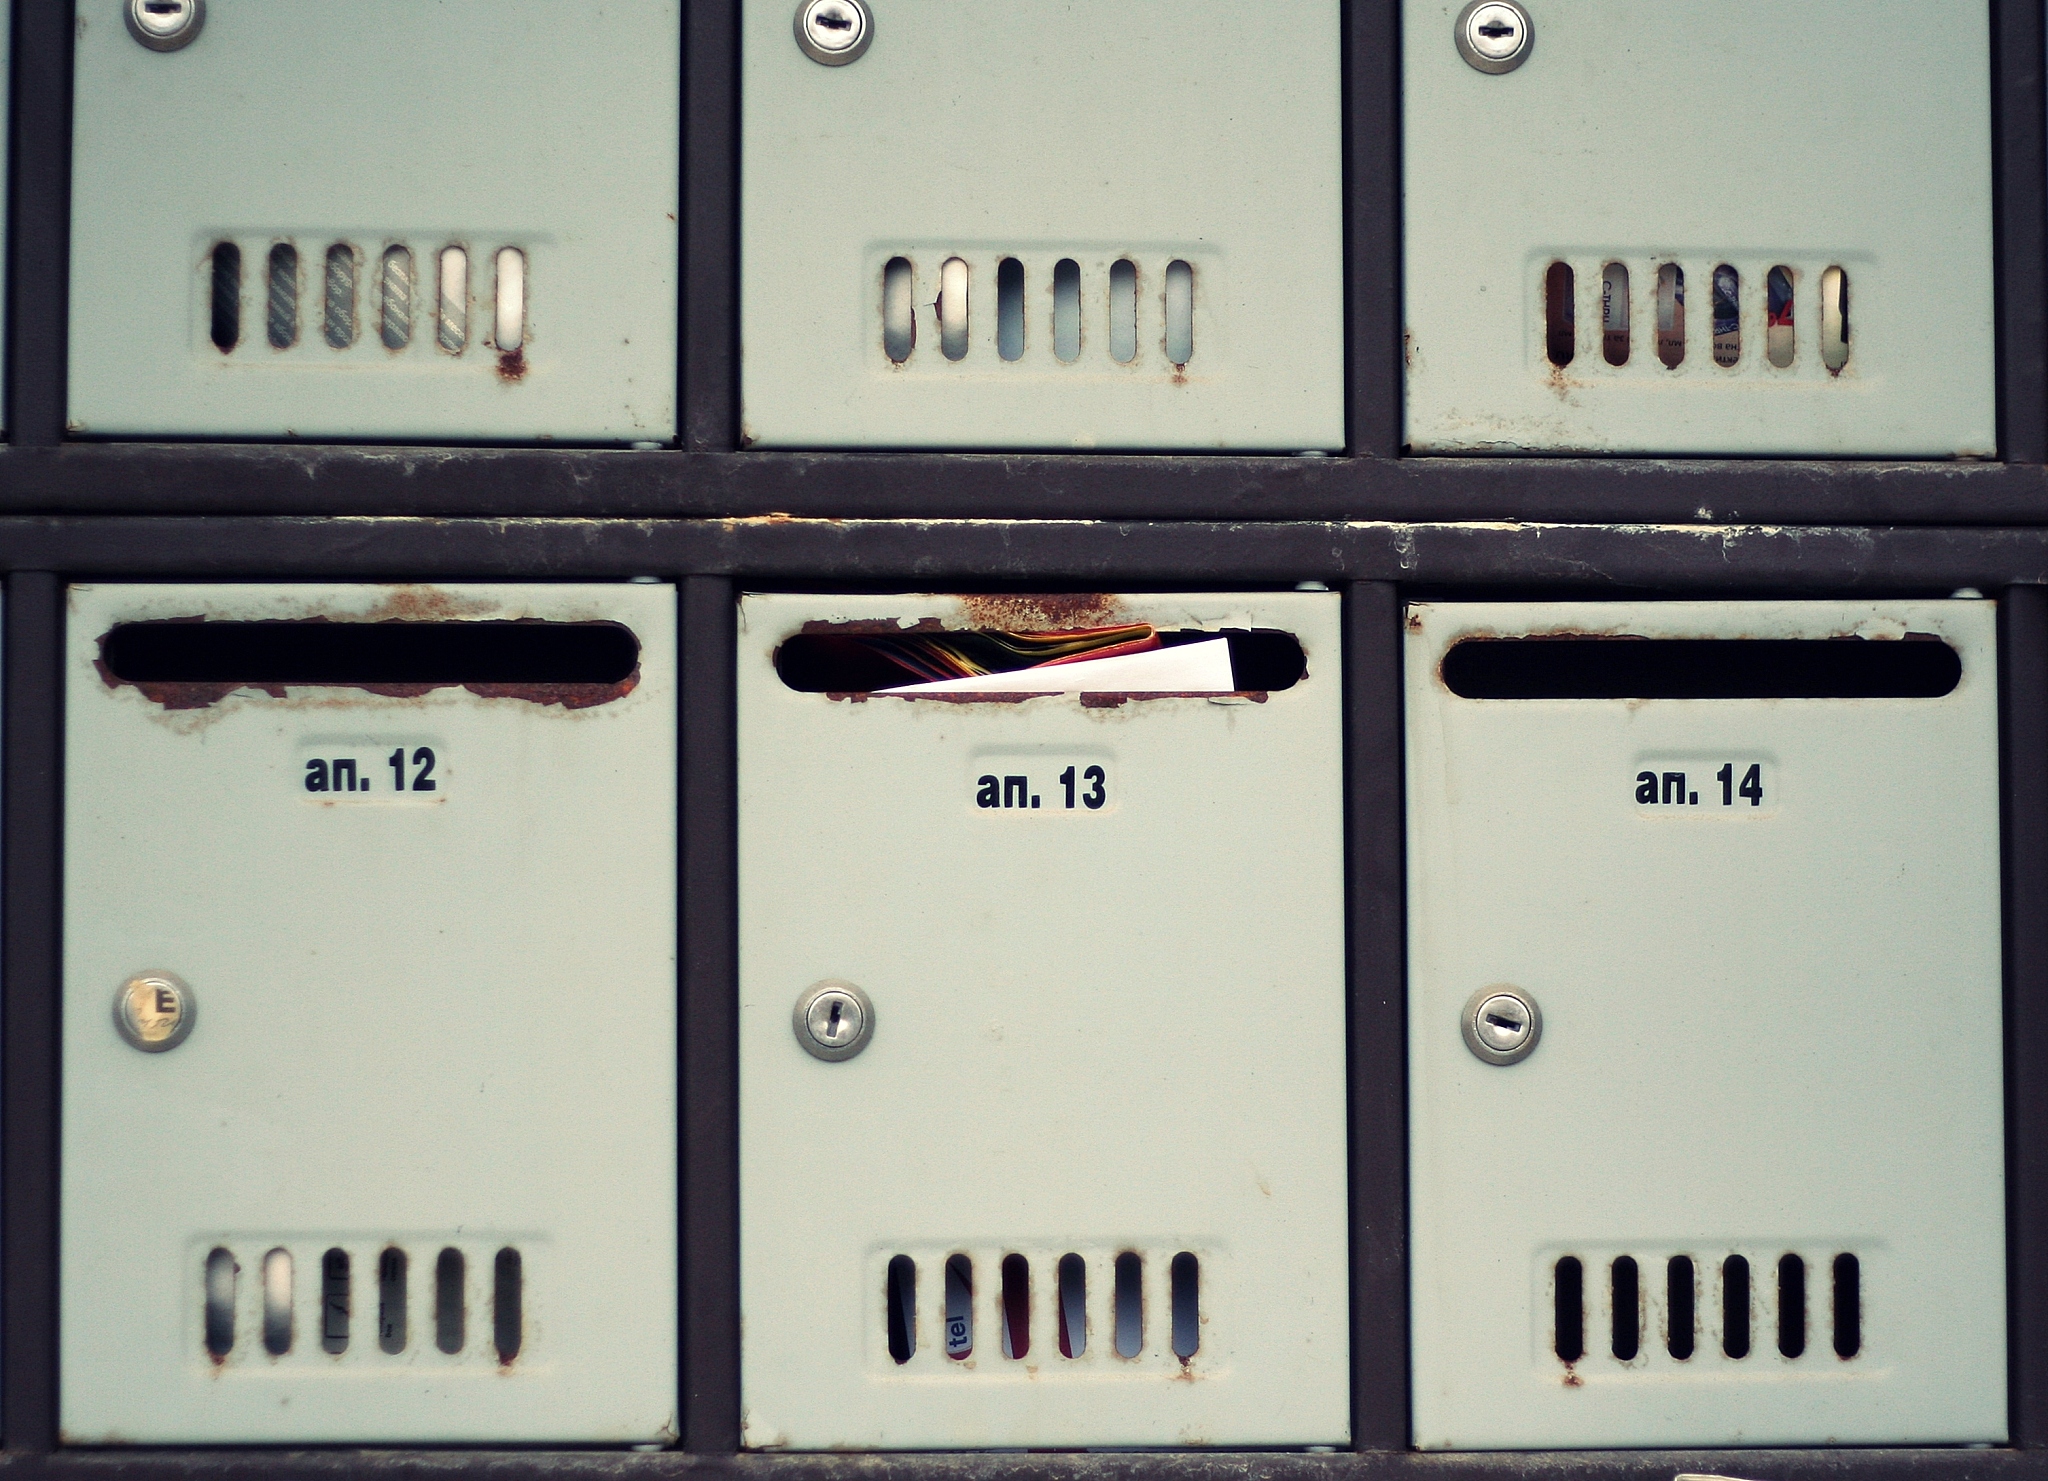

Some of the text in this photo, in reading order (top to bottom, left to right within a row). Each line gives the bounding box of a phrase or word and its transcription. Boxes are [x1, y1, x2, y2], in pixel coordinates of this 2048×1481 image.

[305, 746, 436, 792] ап. 12
[976, 764, 1106, 809] ап. 13
[1635, 762, 1763, 807] ап. 14
